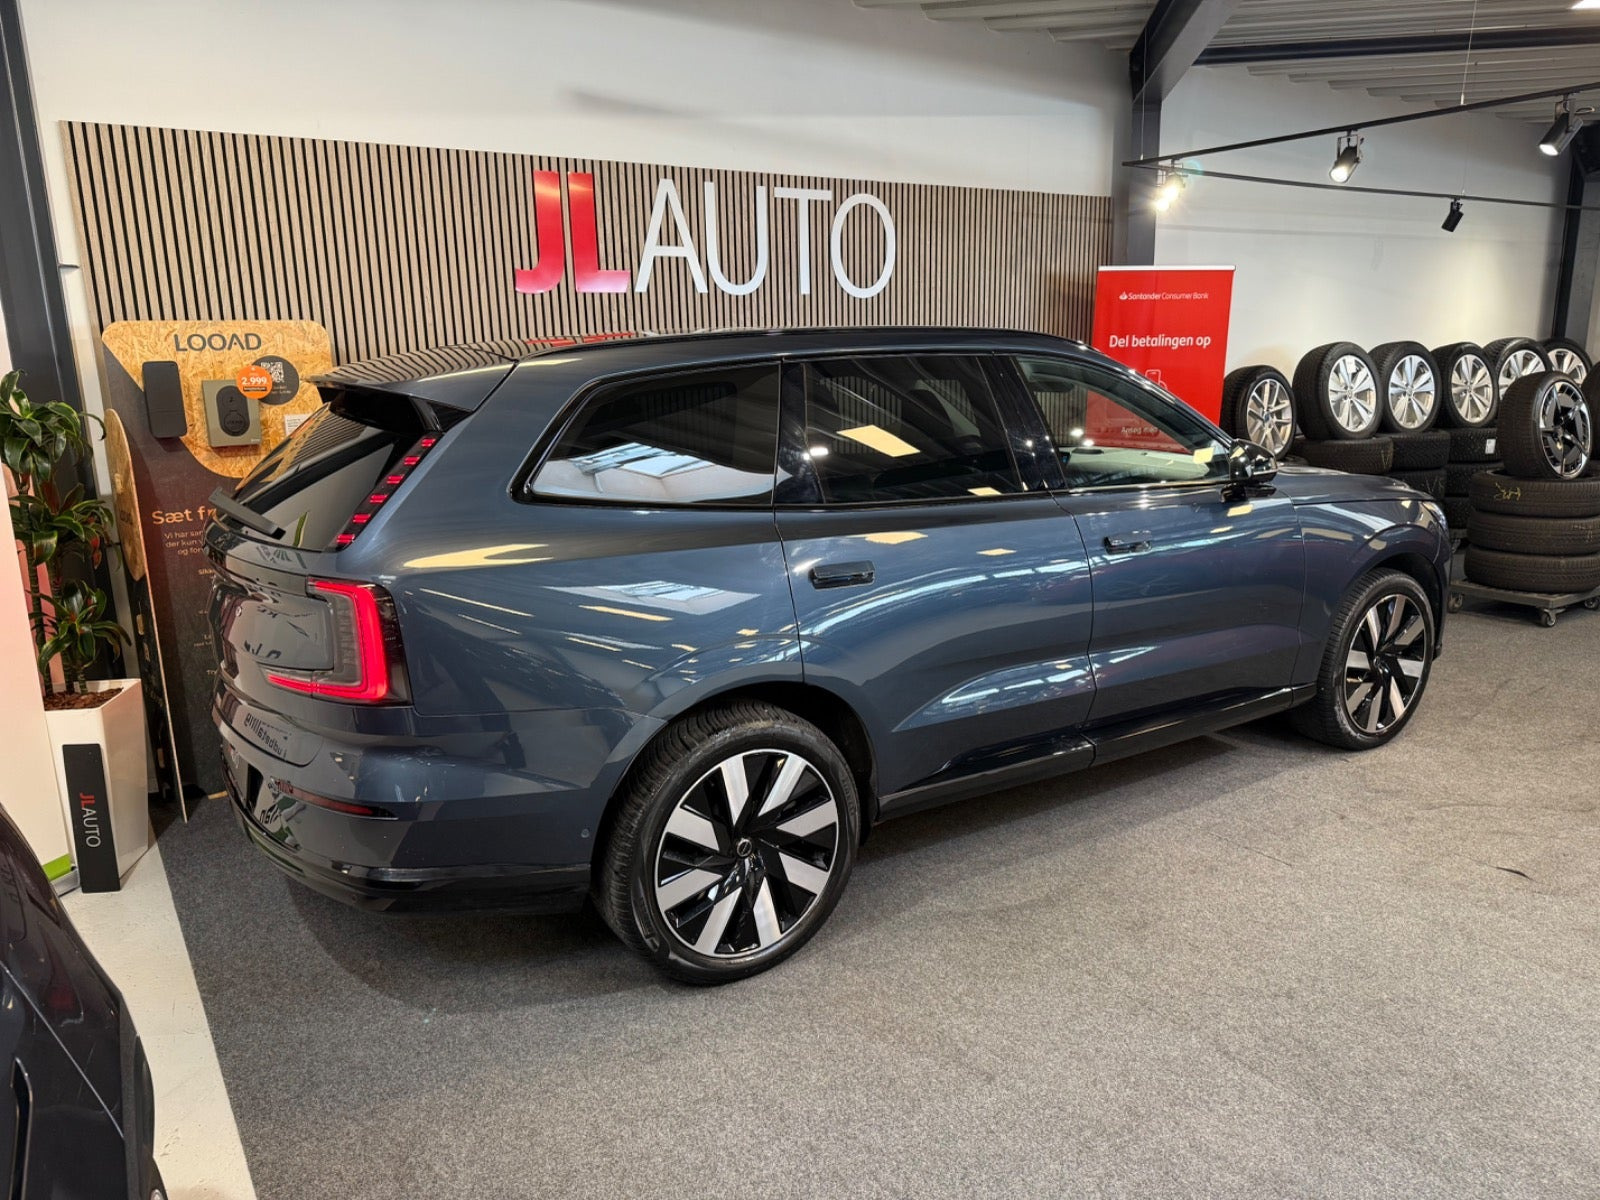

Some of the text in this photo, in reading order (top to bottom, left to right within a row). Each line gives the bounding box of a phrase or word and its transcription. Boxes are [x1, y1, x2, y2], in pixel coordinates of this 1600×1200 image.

[1128, 291, 1209, 300] Santander Consumer Bank
[174, 333, 262, 352] LOOAD
[1109, 334, 1211, 350] Del betalingen op
[241, 377, 268, 386] 2.999
[152, 508, 193, 525] Sæt
